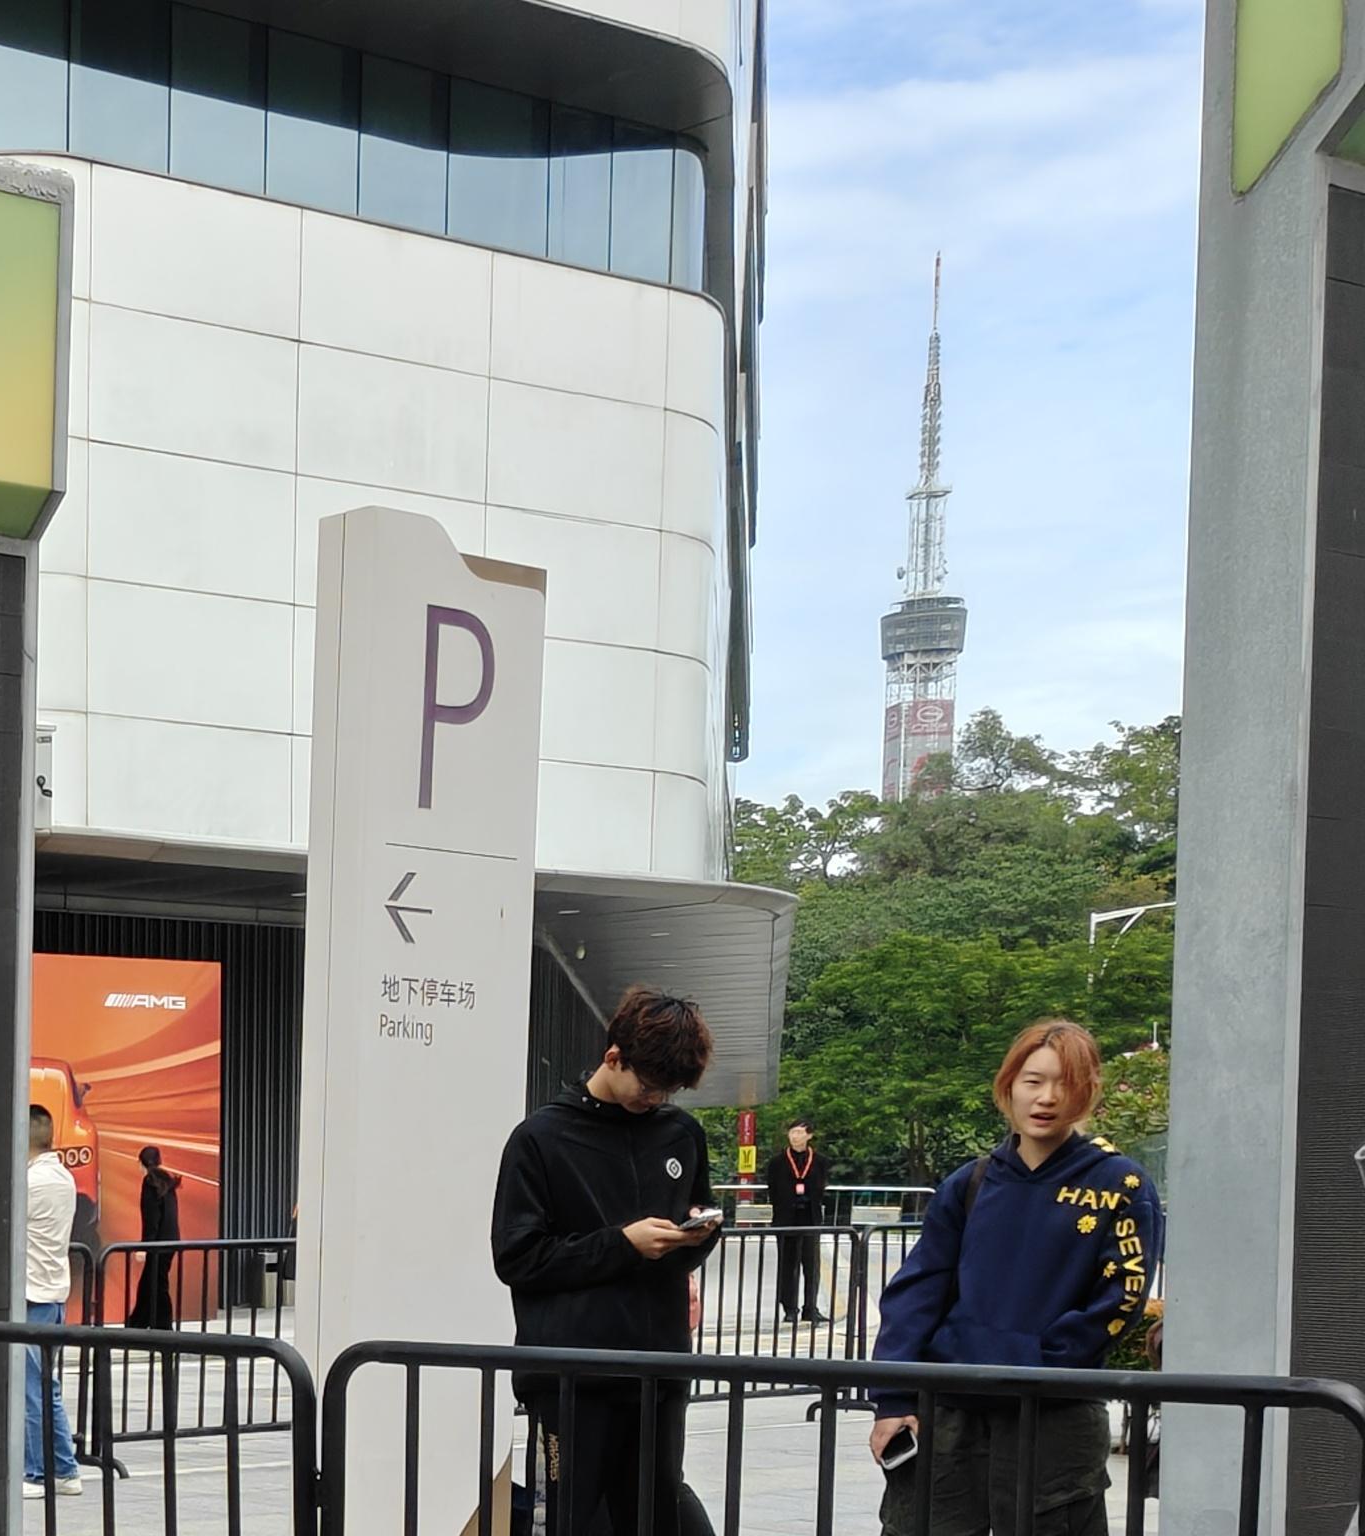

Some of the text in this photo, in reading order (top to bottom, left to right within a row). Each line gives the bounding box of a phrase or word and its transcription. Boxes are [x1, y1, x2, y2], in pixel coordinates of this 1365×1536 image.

[418, 604, 495, 810] P
[131, 994, 186, 1010] AMG
[381, 973, 475, 1010] 地下停车场
[379, 1013, 433, 1046] Parking
[1115, 1218, 1146, 1312] SEVEN
